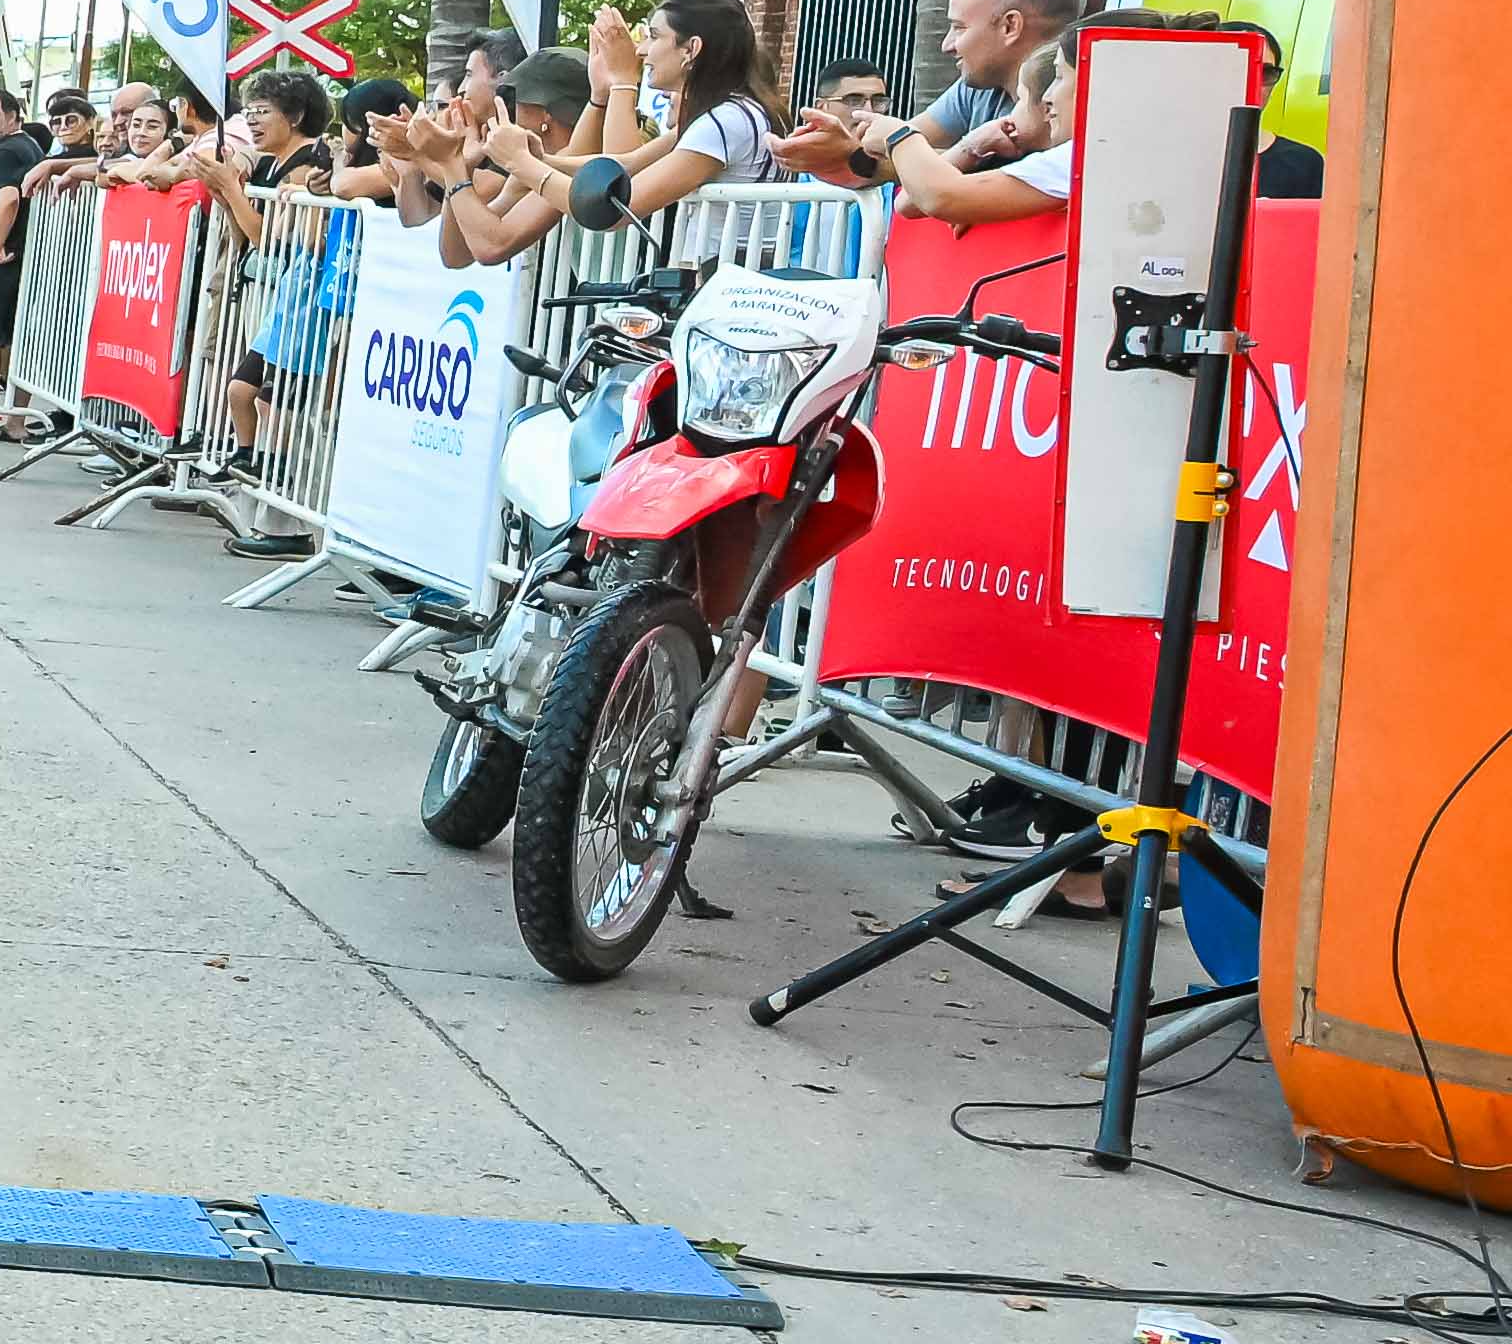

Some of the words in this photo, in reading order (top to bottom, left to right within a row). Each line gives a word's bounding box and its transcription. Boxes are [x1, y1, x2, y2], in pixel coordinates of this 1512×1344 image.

[103, 218, 171, 320] moplex
[721, 287, 840, 316] ORGANIZACION
[729, 300, 811, 321] MARATON
[728, 327, 779, 337] HONDA
[364, 329, 472, 421] CARUSO
[892, 558, 1044, 606] TECNOLOGI
